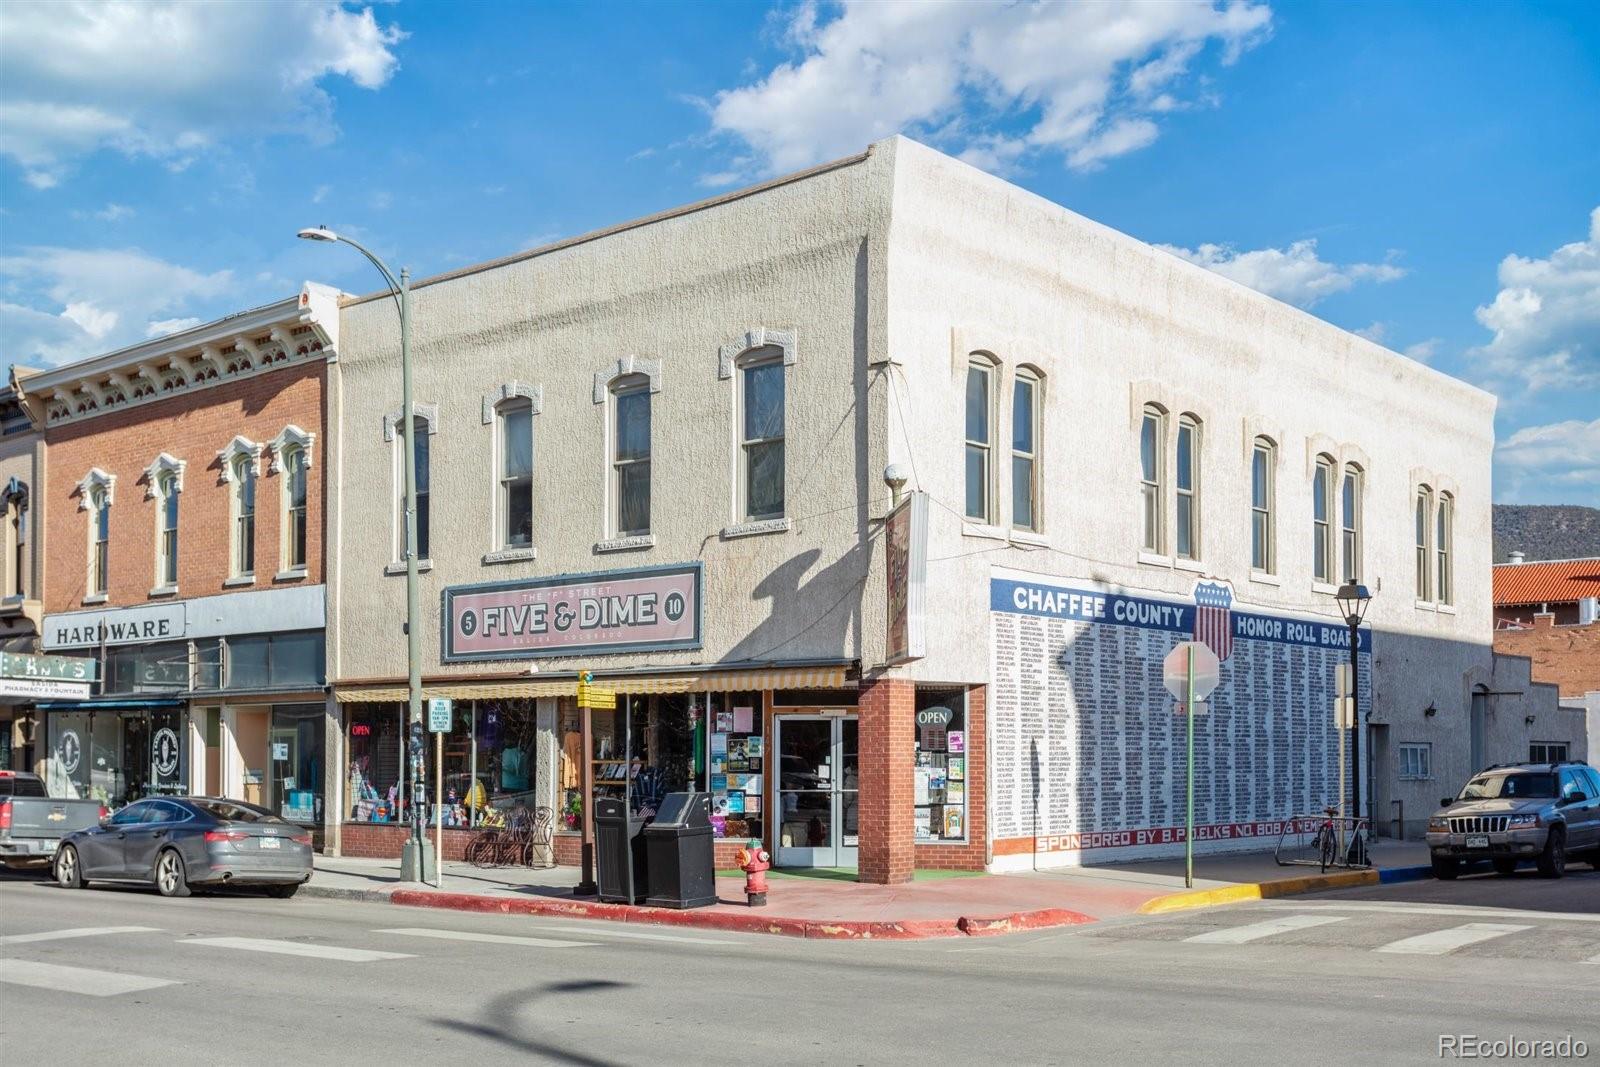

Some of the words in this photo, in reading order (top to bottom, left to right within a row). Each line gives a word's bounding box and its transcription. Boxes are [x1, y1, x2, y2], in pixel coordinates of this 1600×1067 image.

[522, 594, 542, 602] THE
[569, 586, 612, 598] STREET
[465, 616, 472, 630] 5
[482, 603, 547, 637] FIVE
[553, 601, 576, 632] &
[579, 592, 658, 630] DIME
[668, 598, 681, 615] 10
[1013, 587, 1105, 618] CHAFFEE
[1113, 600, 1184, 627] COUNTY
[1237, 616, 1282, 639] HONOR
[1286, 622, 1316, 643] ROLL
[57, 619, 170, 644] HARDWARE
[918, 711, 948, 724] OPEN
[352, 725, 370, 736] OPEN
[1036, 831, 1131, 852] SPONSORED
[1137, 829, 1156, 844] BY
[1257, 821, 1281, 835] 808
